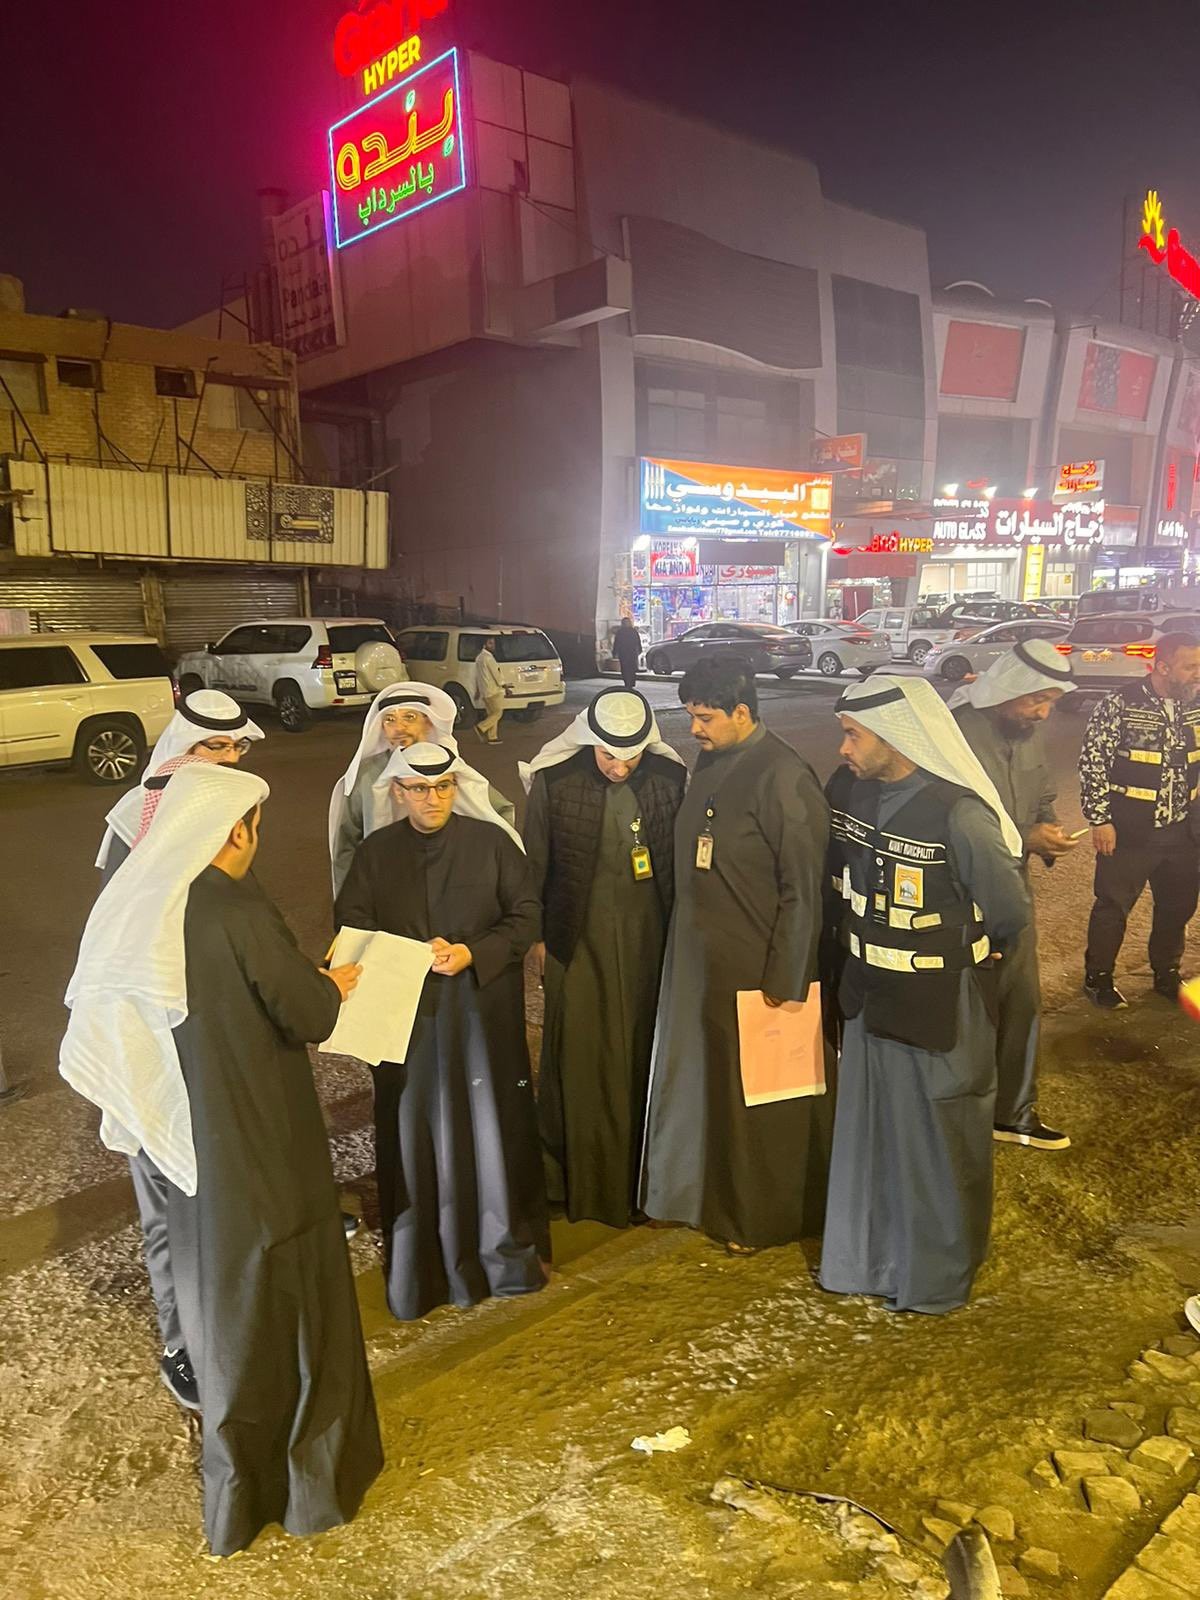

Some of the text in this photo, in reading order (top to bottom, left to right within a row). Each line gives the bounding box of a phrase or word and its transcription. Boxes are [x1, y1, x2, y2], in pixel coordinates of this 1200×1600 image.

[363, 34, 422, 95] HYPER
[336, 88, 456, 191] بنده
[358, 161, 436, 225] بالسرداب
[1060, 460, 1096, 478] زجاج
[899, 537, 934, 552] HYPER
[933, 521, 957, 539] AUTO
[995, 510, 1105, 545] زجاج السيارات
